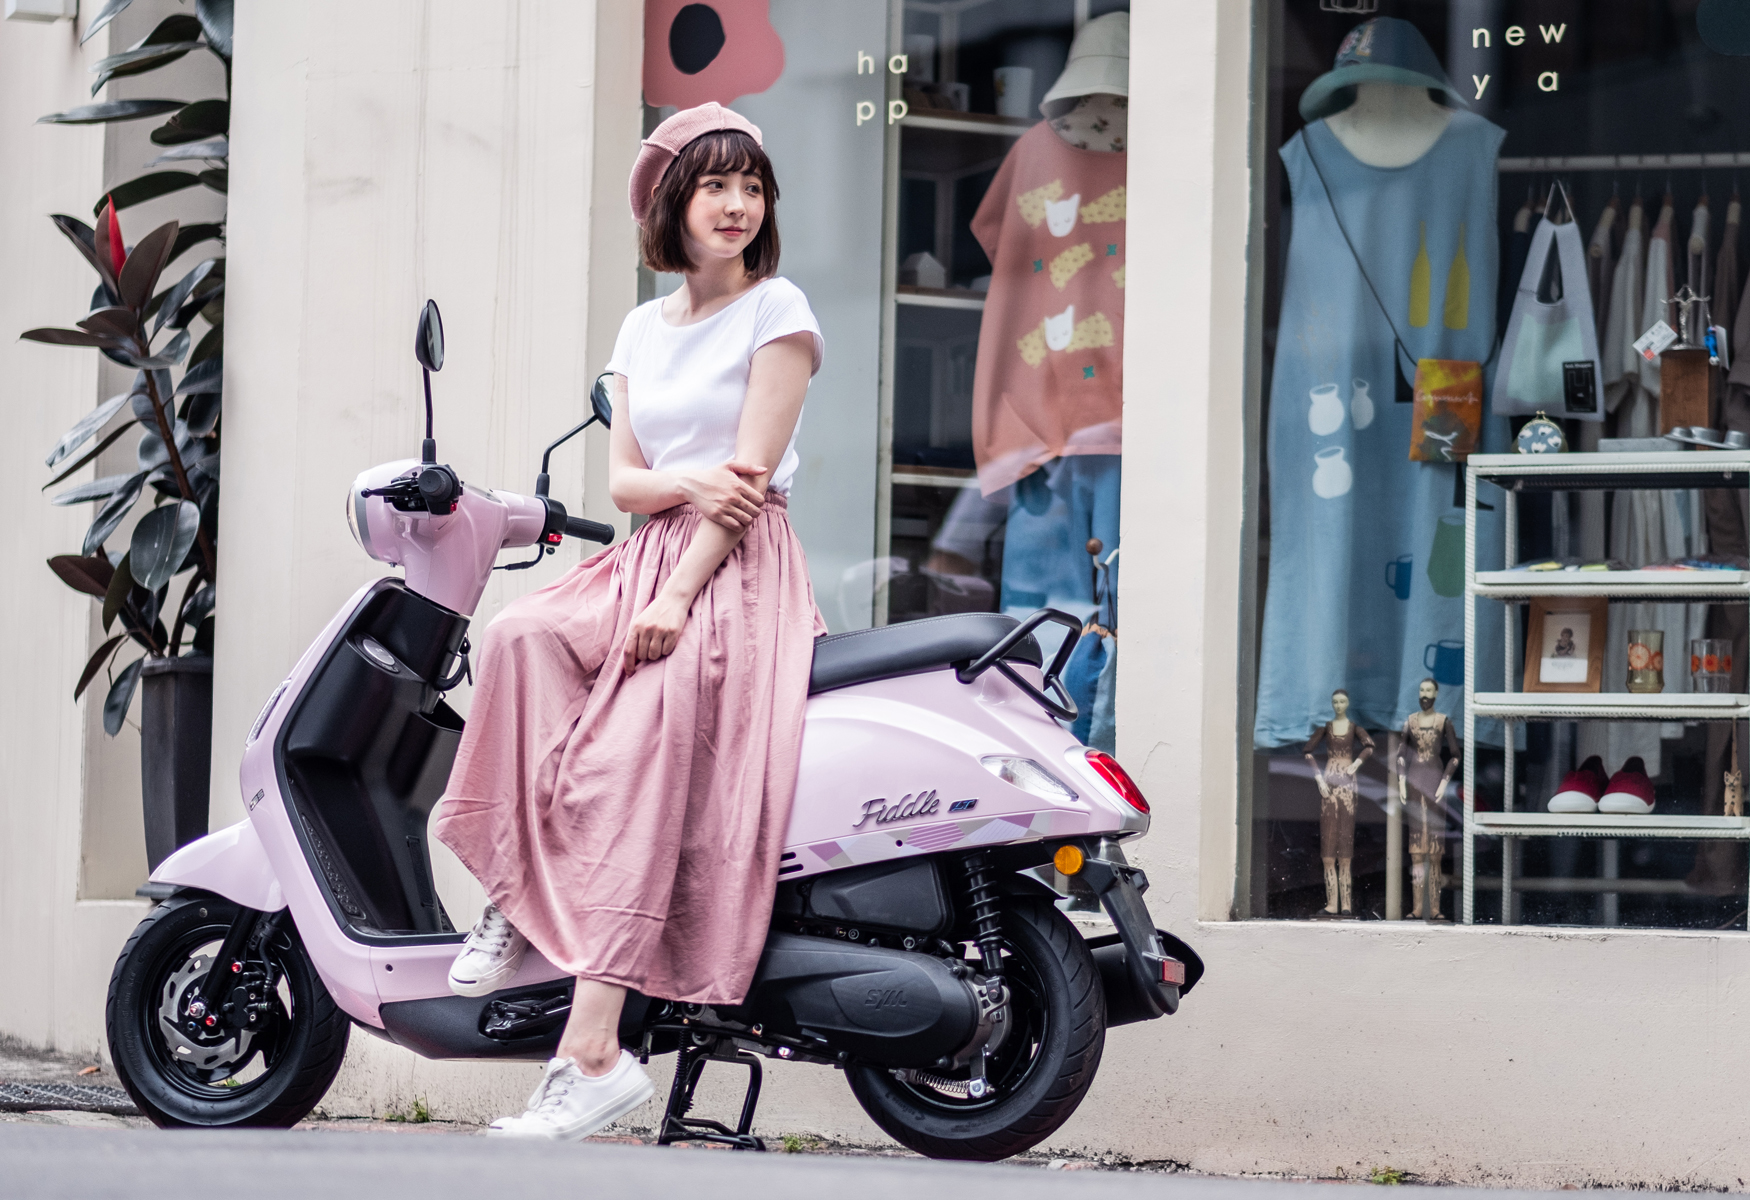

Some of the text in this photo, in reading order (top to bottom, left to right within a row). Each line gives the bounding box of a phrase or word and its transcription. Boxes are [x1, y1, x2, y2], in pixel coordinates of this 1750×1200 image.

[1472, 23, 1567, 49] new
[853, 789, 940, 828] Fiddle
[865, 988, 907, 1011] SYM
